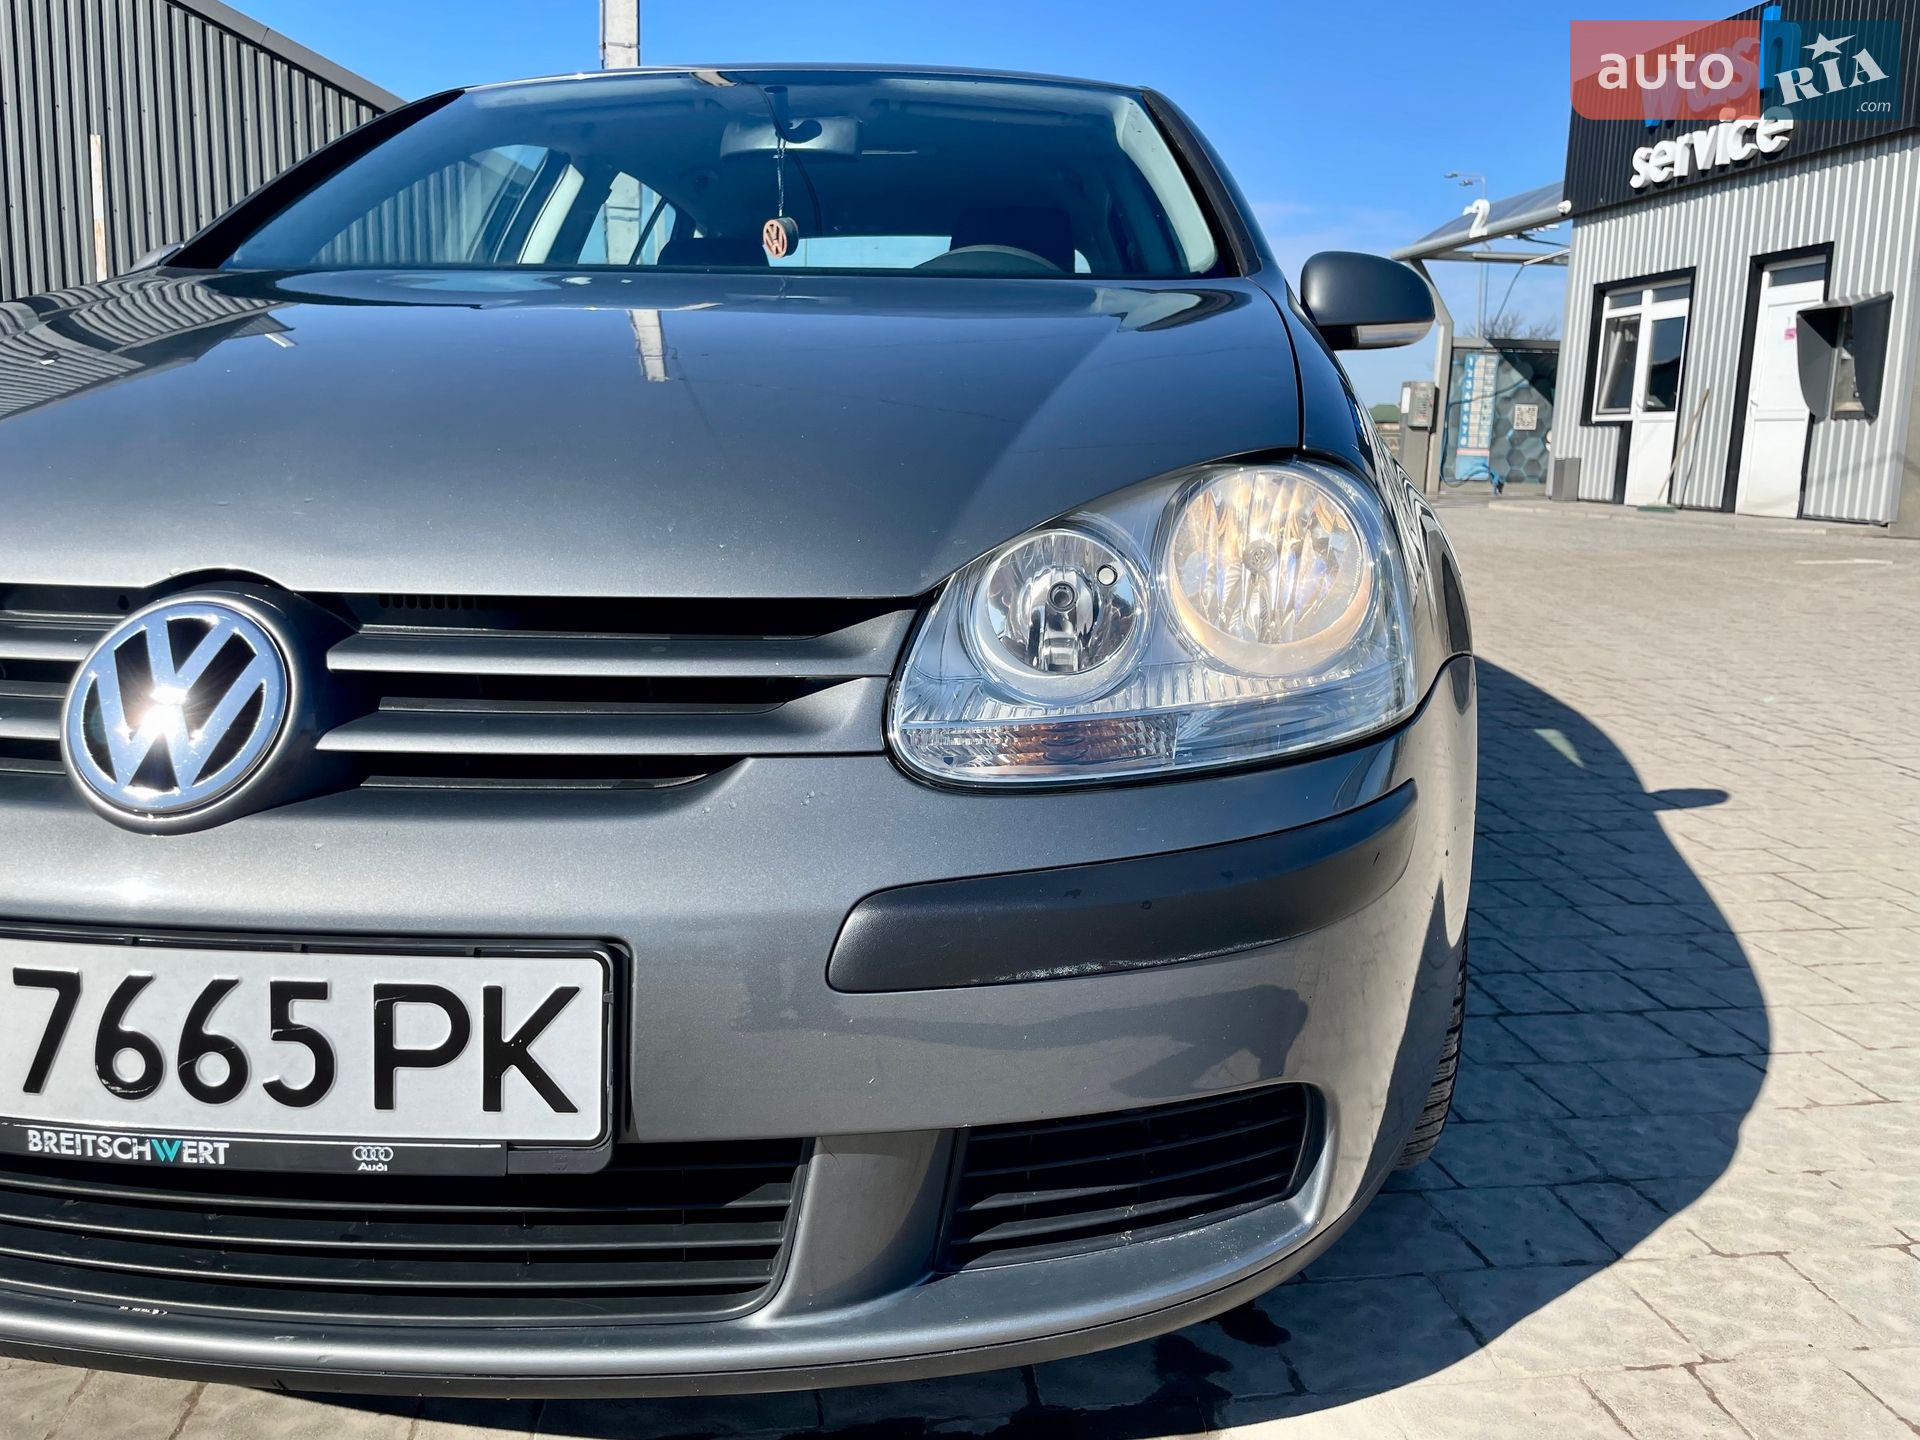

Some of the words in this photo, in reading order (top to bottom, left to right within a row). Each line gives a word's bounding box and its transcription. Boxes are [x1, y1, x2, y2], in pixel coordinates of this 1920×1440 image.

[1629, 106, 1794, 189] service
[1462, 198, 1490, 239] 2
[27, 1129, 229, 1165] BREITSCHWERT
[357, 1162, 388, 1172] Audi
